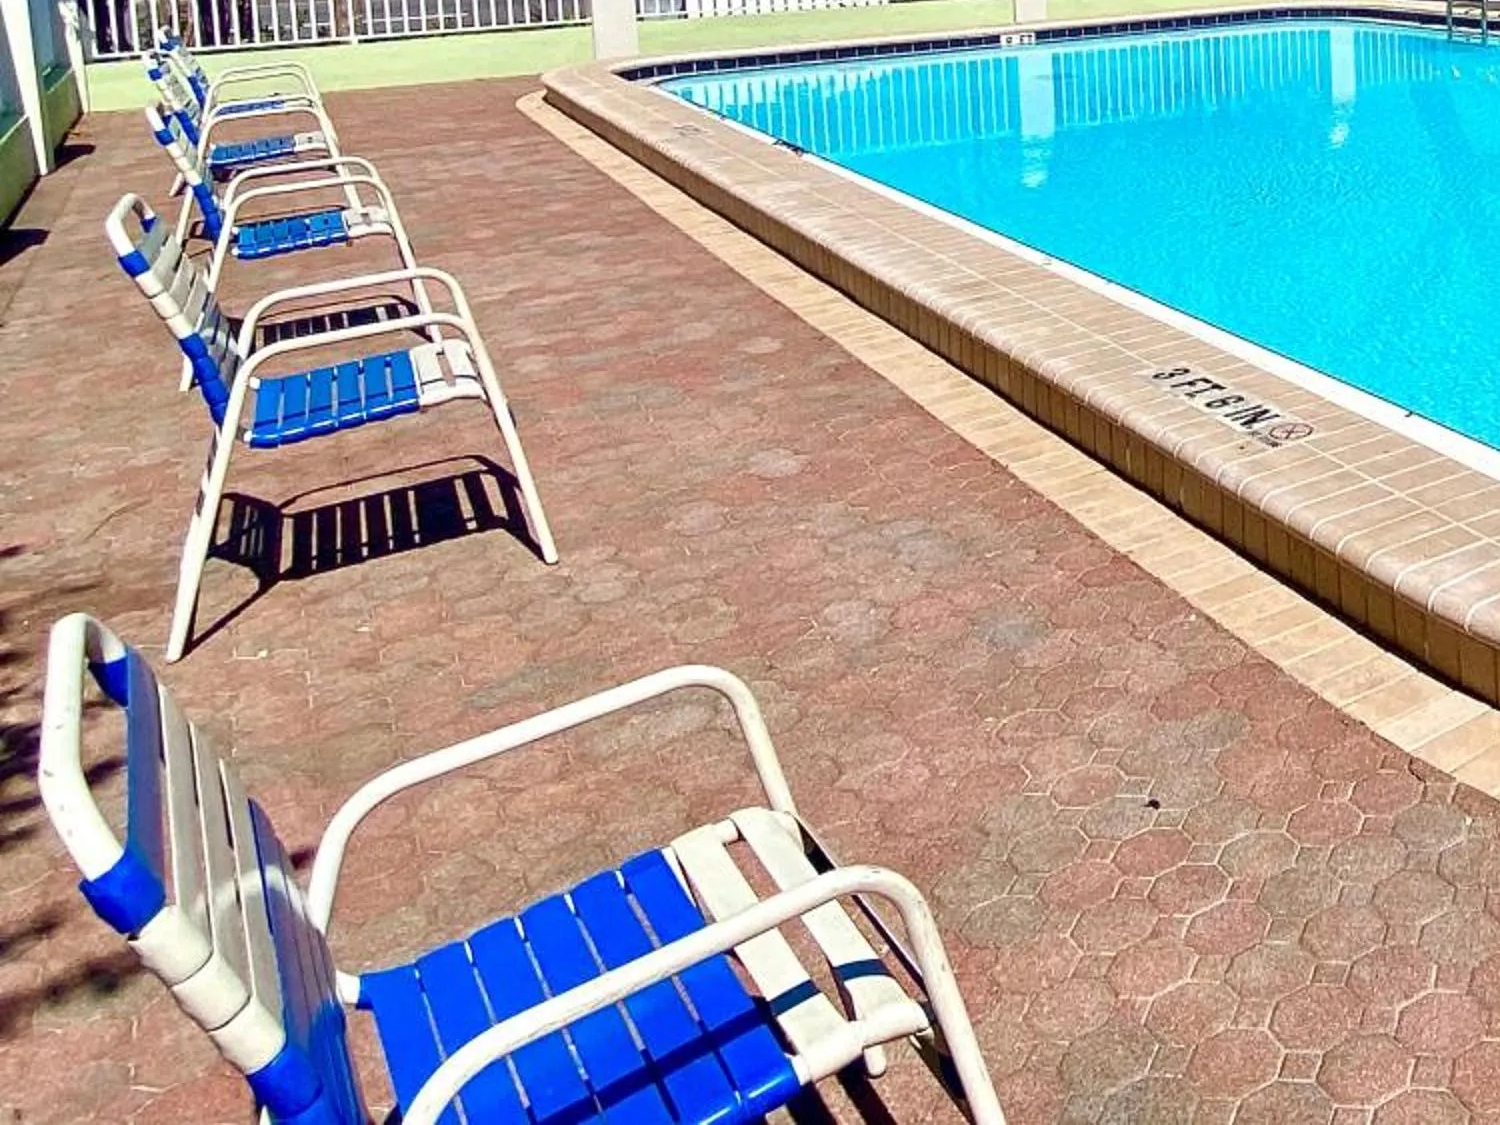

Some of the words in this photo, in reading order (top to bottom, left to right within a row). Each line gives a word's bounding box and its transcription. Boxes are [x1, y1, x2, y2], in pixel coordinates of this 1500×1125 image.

[1152, 367, 1191, 380] 3
[1169, 377, 1228, 398] FT
[1205, 394, 1245, 410] 6
[1223, 405, 1281, 429] IN
